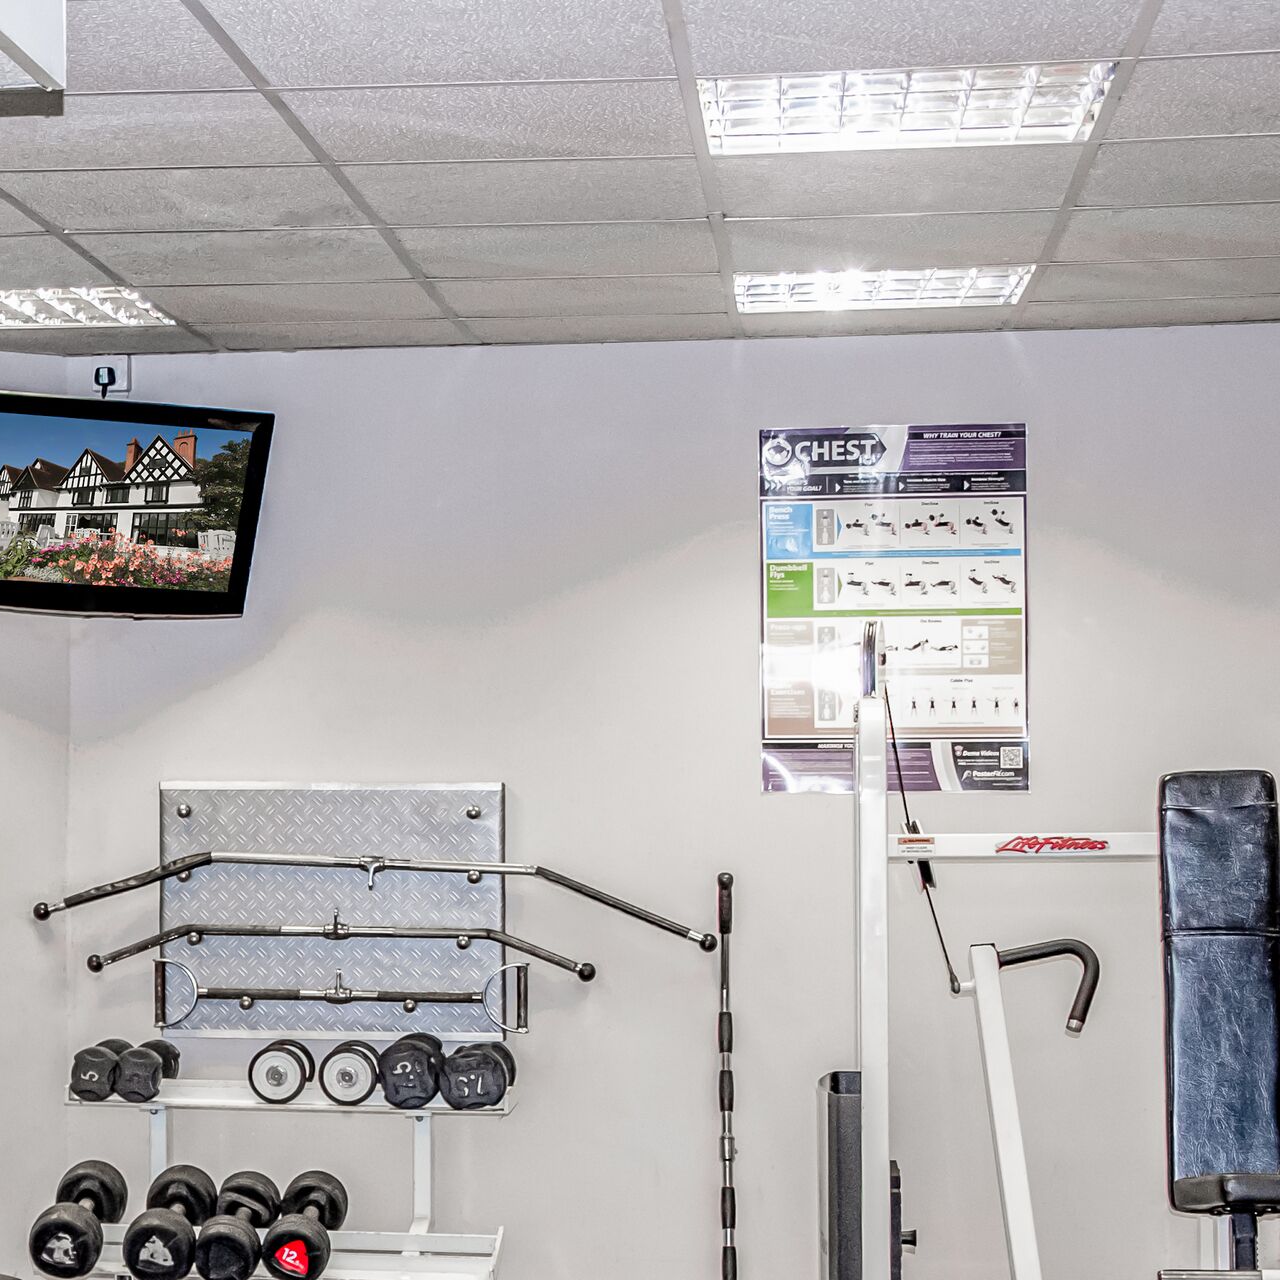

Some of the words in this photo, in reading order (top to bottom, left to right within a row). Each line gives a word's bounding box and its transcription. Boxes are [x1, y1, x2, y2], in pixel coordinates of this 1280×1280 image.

[794, 440, 876, 462] CHEST
[770, 564, 807, 572] Dumbbell
[80, 1071, 100, 1082] 5
